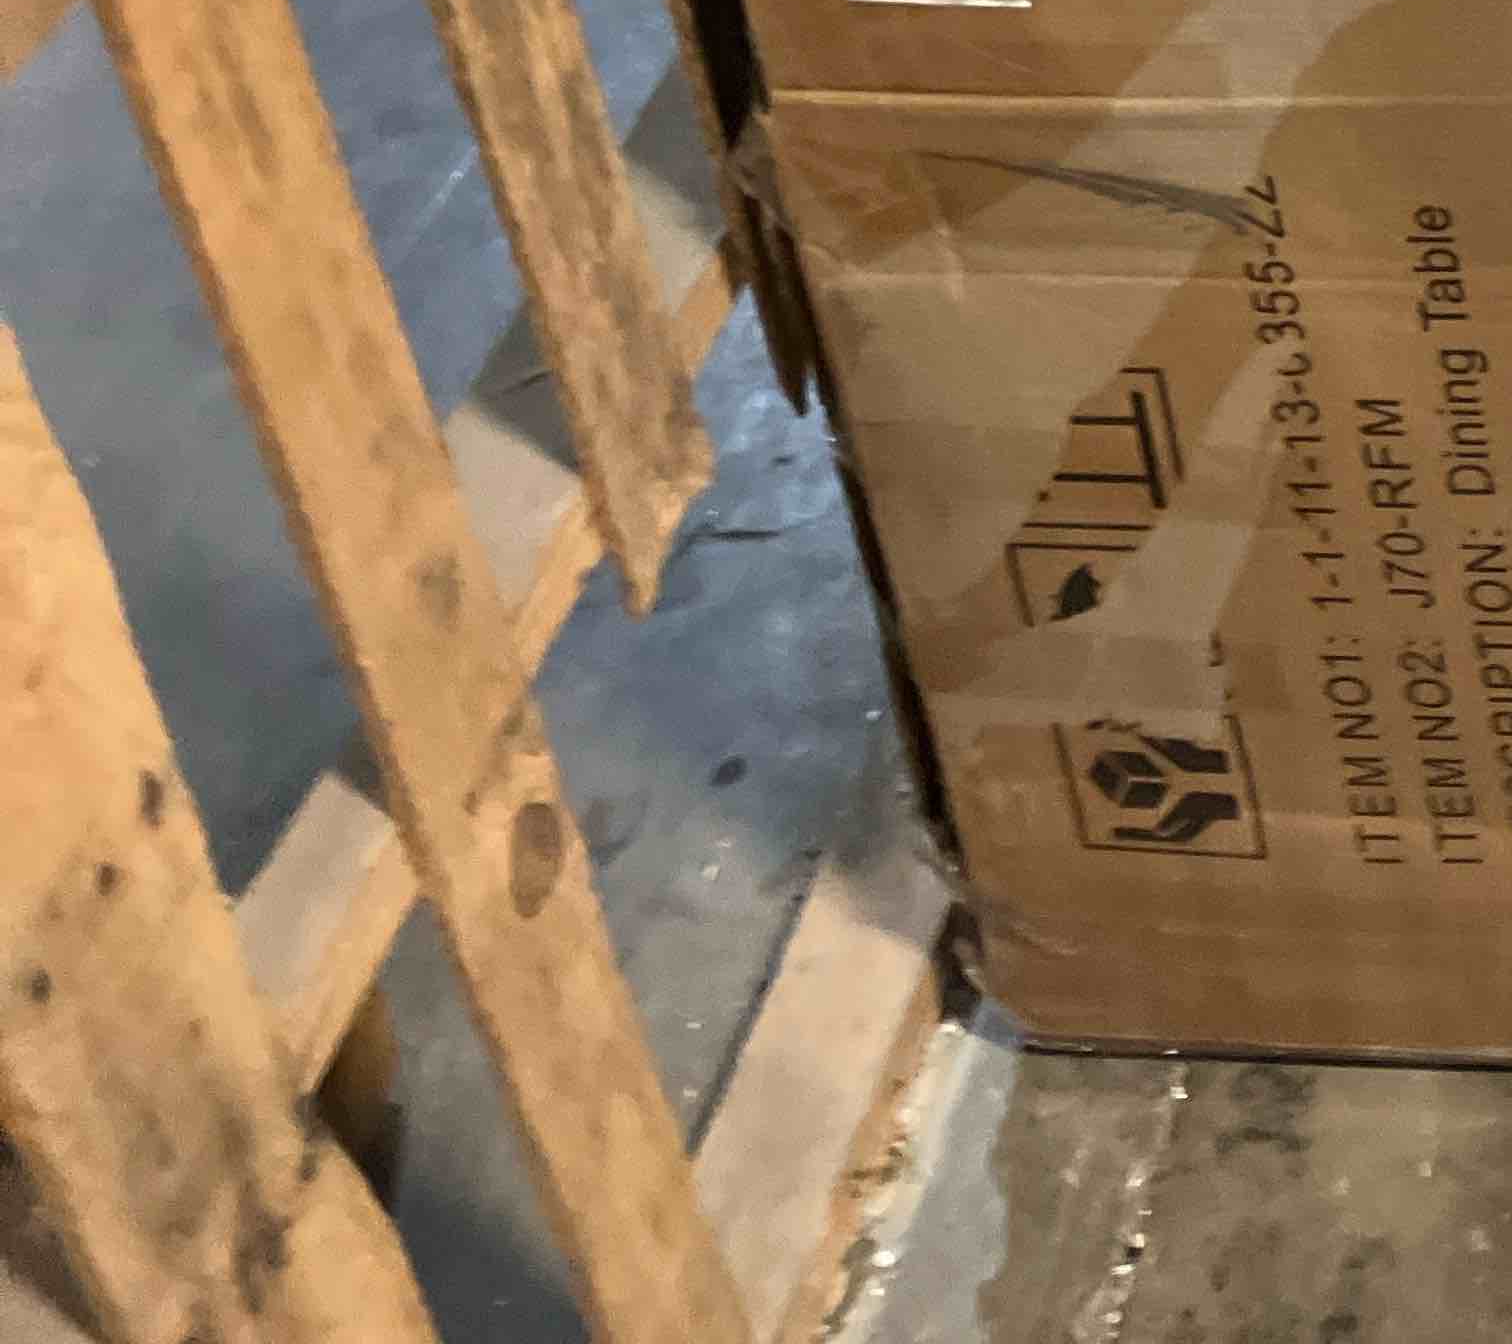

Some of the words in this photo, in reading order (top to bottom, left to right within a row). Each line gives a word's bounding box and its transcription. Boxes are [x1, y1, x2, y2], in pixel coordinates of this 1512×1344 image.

[1405, 204, 1471, 332] Table
[1436, 347, 1496, 496] Dining
[1354, 398, 1437, 609] J70-RFM
[1321, 634, 1379, 740] NO1:
[1398, 639, 1460, 741] NO2:
[1342, 756, 1405, 863] ITEM
[1421, 758, 1484, 863] ITEM
